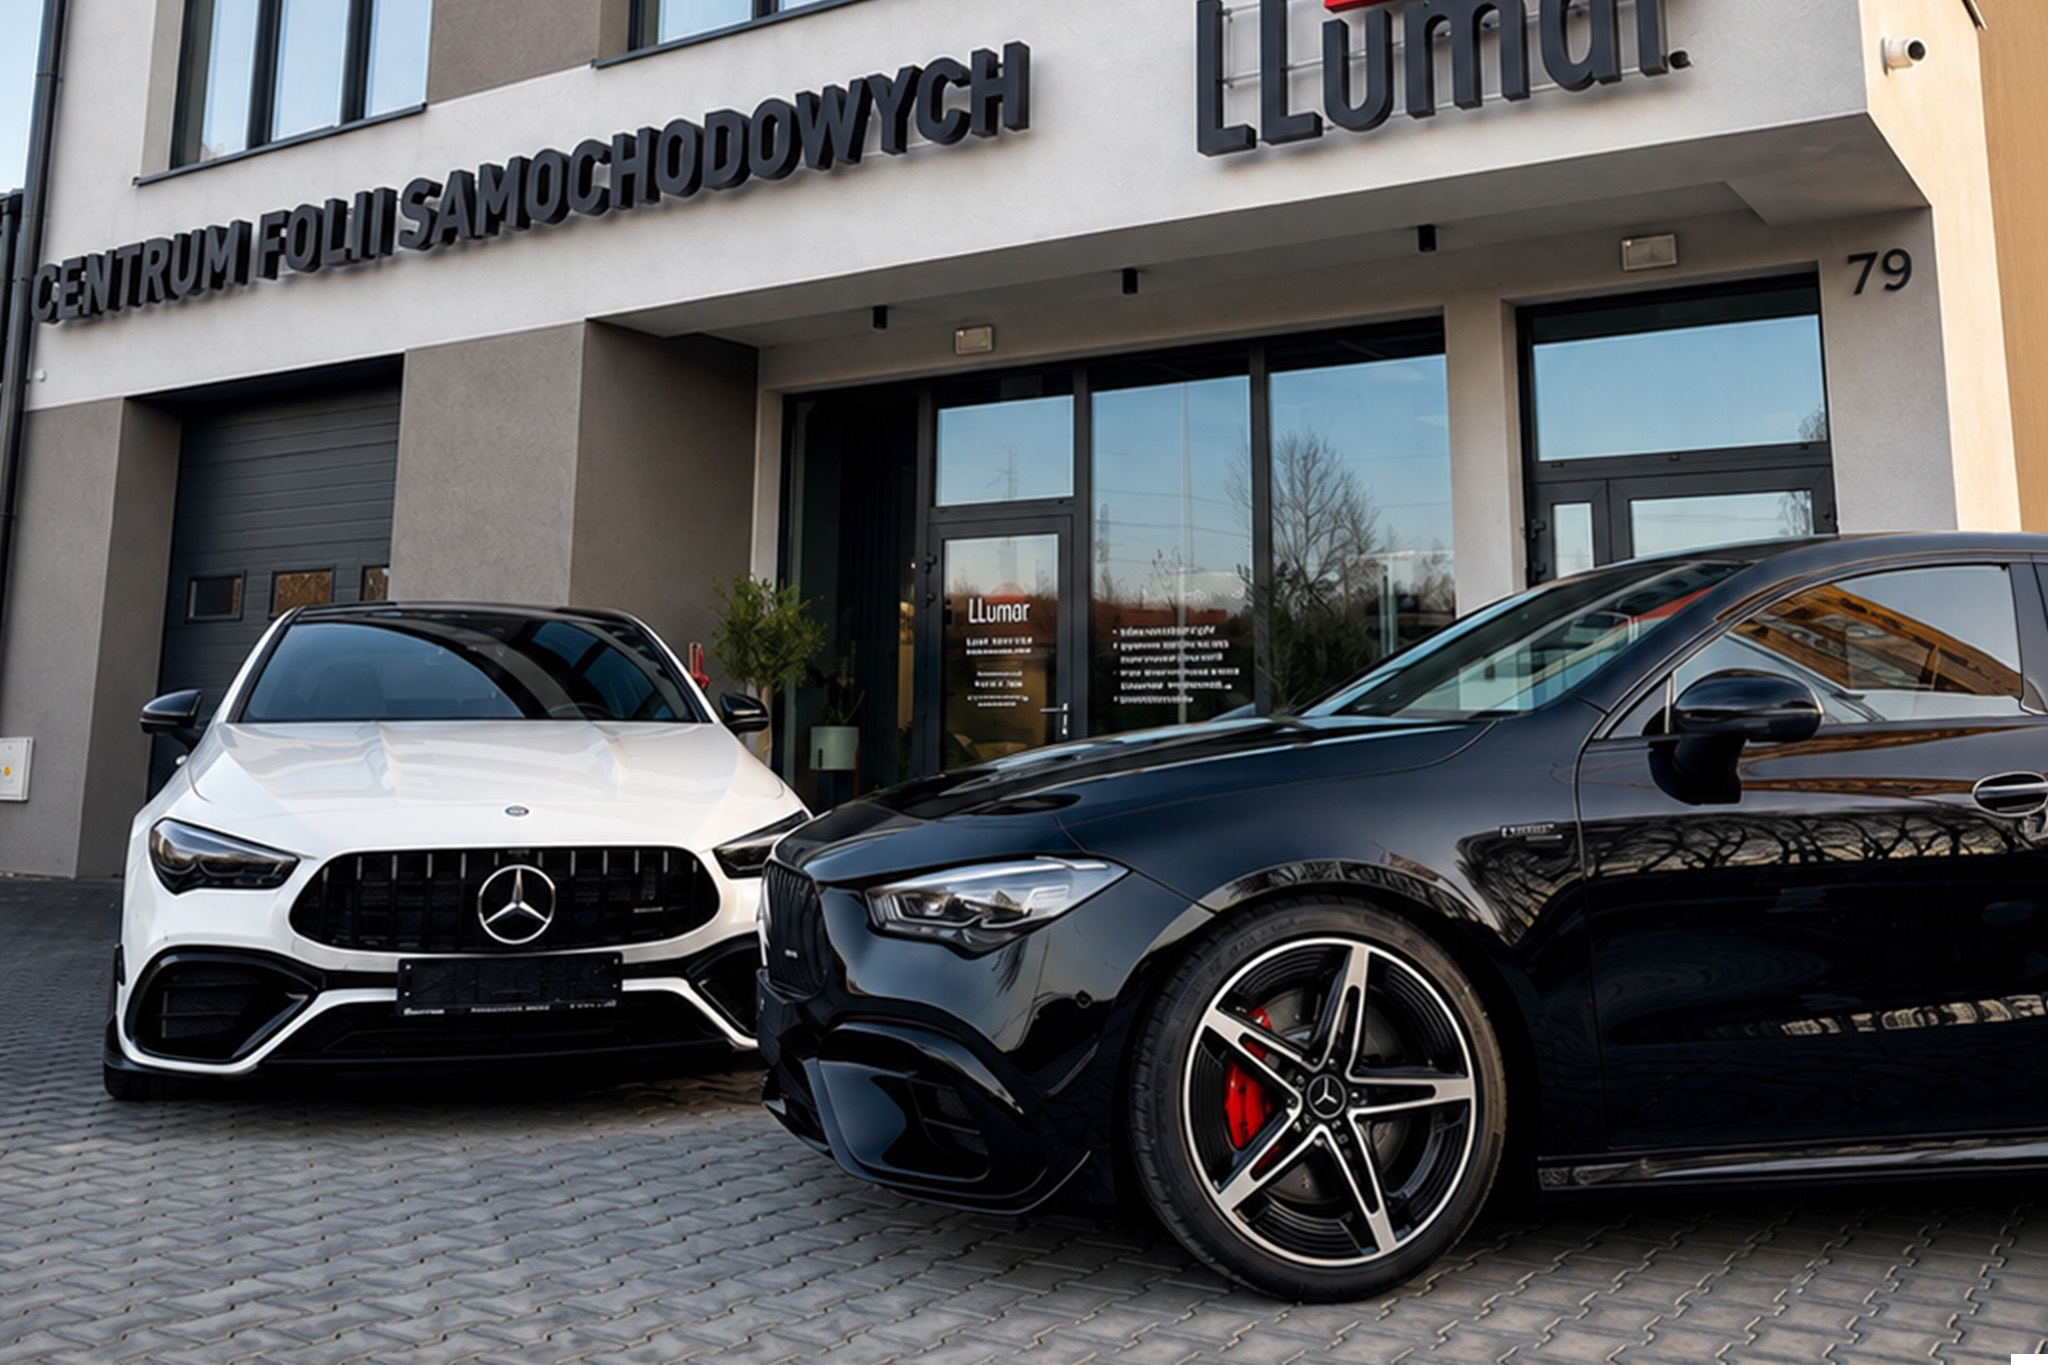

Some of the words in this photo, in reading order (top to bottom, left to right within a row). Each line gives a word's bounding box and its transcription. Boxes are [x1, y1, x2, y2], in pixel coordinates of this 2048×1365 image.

[31, 219, 253, 323] CENTRUM
[256, 187, 397, 280] FOLII
[399, 40, 1030, 250] SAMOCHODOWYCH
[1847, 248, 1912, 295] 79
[968, 597, 1031, 624] LLumar
